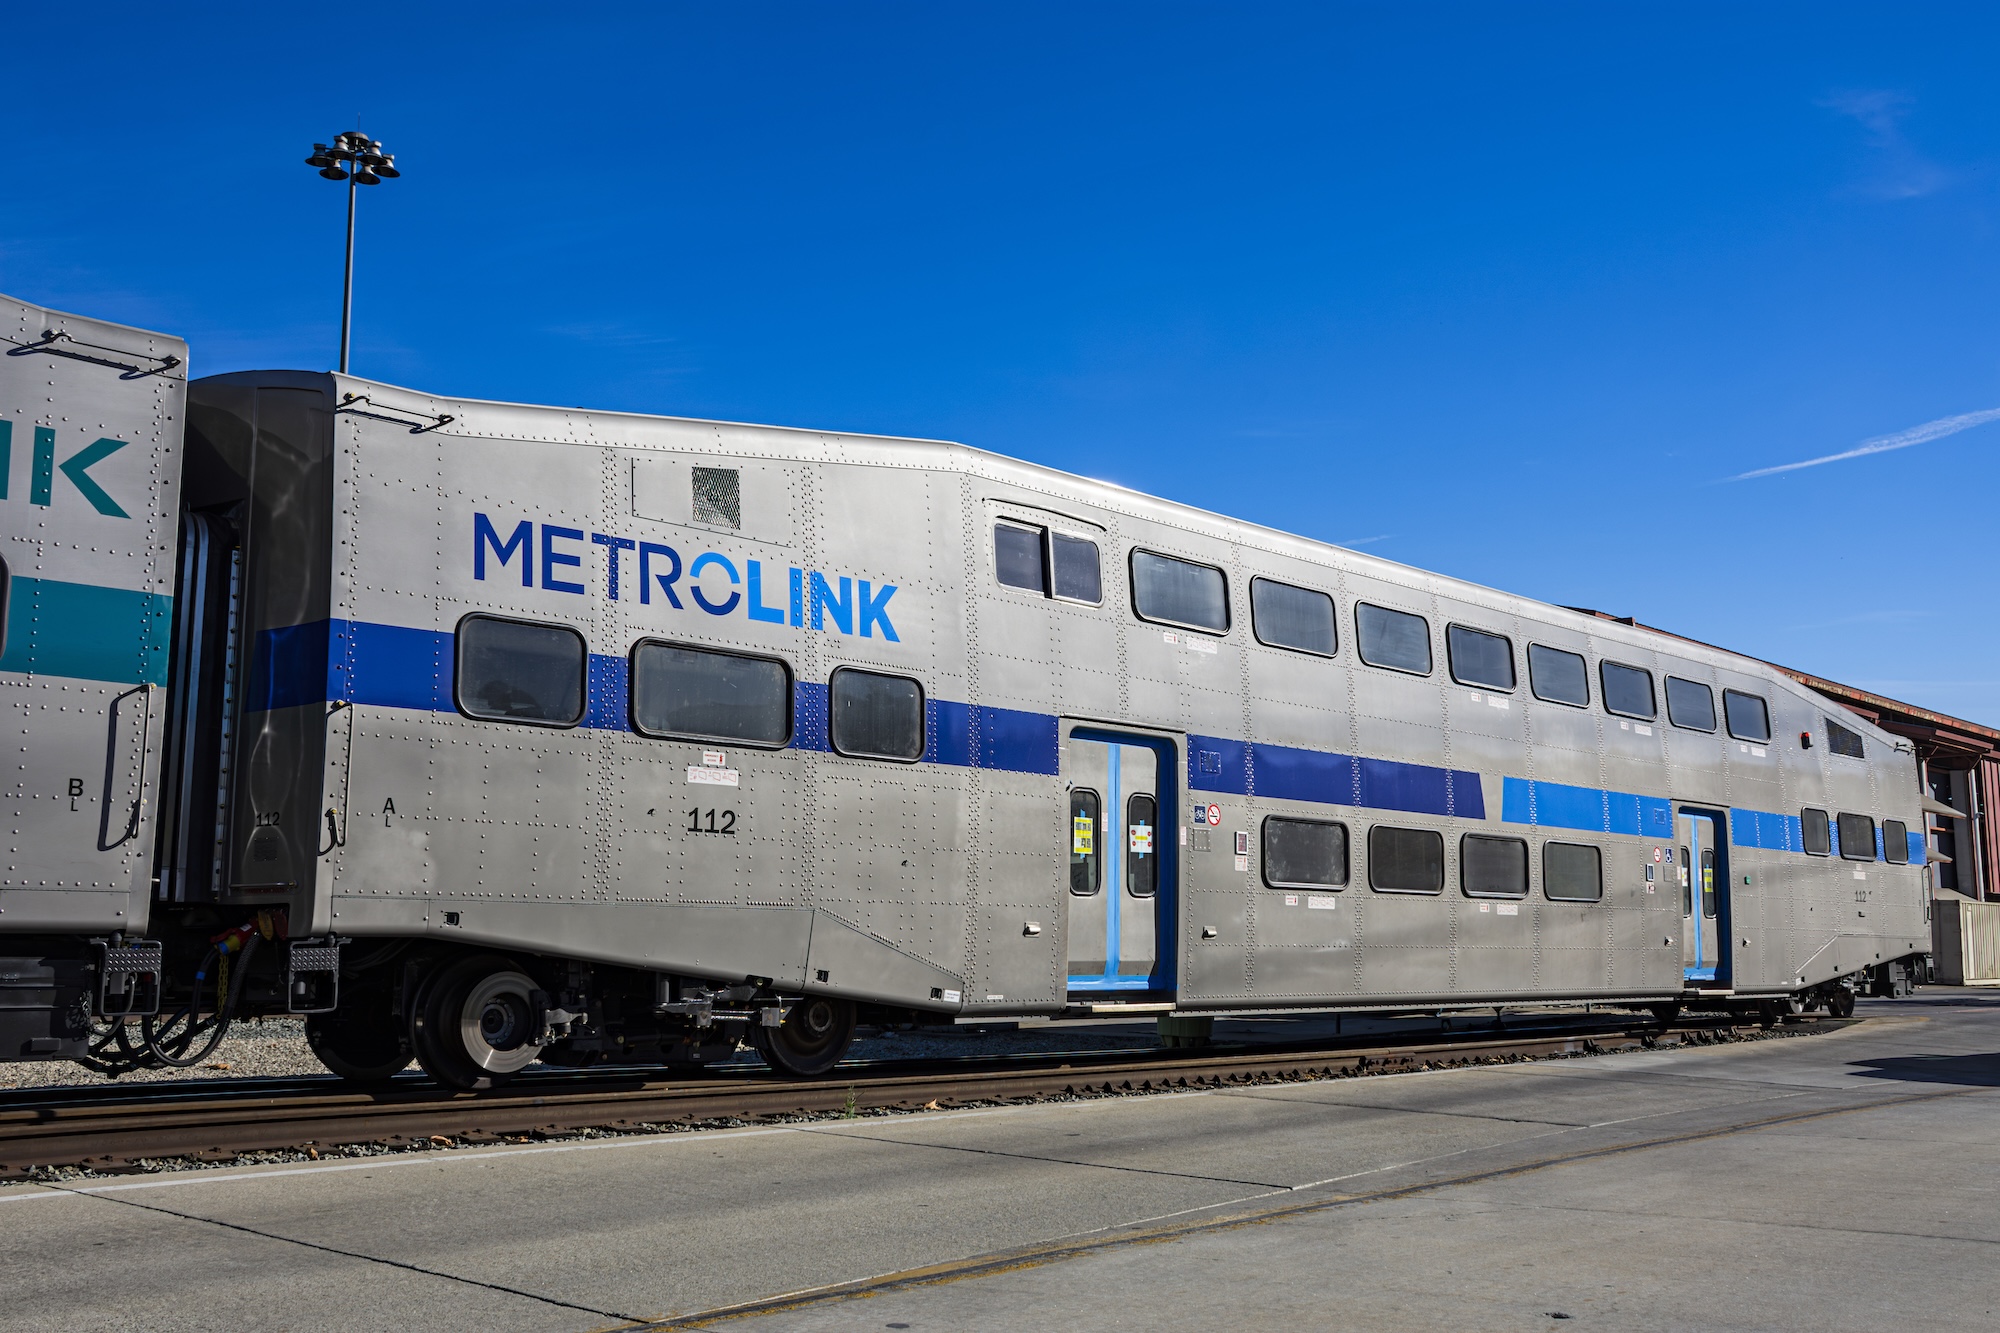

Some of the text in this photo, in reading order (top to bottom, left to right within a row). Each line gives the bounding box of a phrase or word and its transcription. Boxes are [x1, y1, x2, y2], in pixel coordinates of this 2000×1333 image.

[474, 512, 901, 643] METROLINK
[68, 778, 83, 796] B
[70, 800, 79, 811] L
[382, 797, 396, 814] A
[256, 811, 280, 827] 112
[385, 816, 392, 828] L
[687, 807, 736, 835] 112
[1855, 890, 1867, 902] 112
